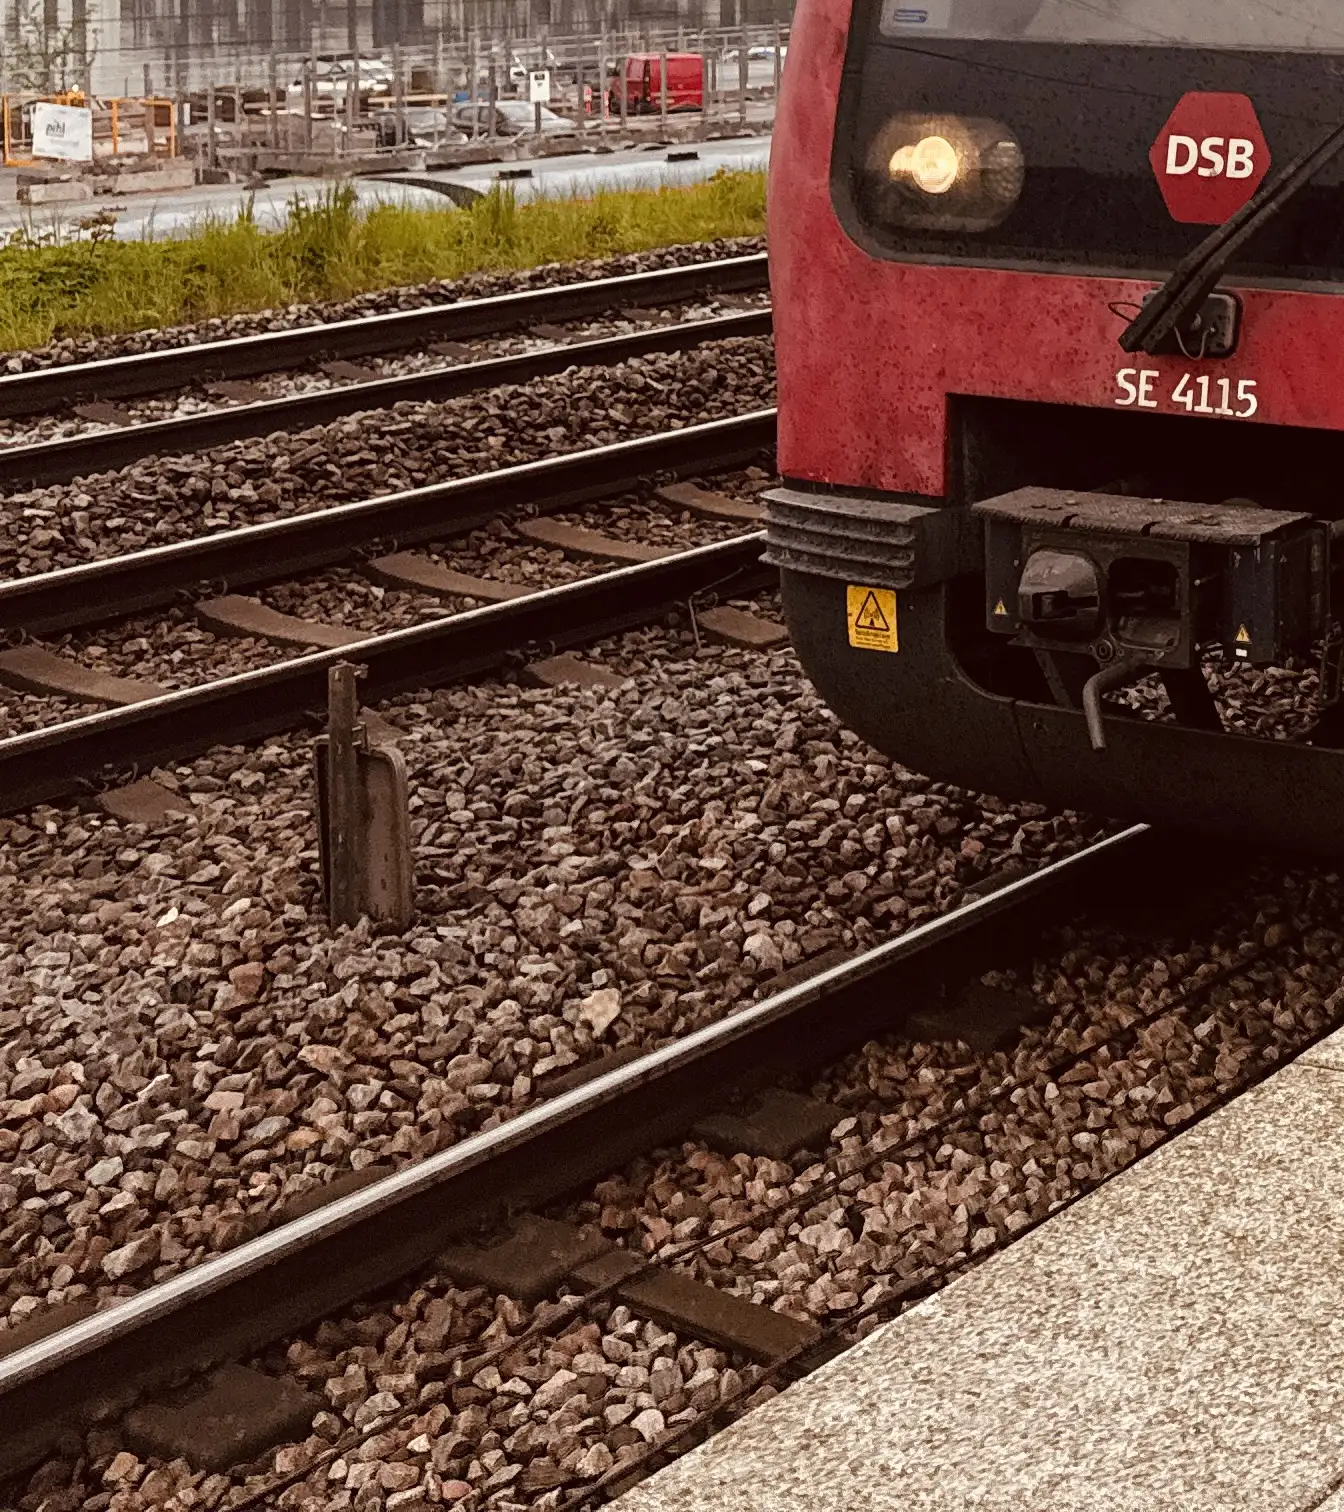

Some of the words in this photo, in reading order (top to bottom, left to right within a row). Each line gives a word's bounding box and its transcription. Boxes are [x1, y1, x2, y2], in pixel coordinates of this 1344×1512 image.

[1165, 135, 1255, 180] DSB
[1115, 367, 1158, 408] SE
[1171, 374, 1259, 419] 4115
